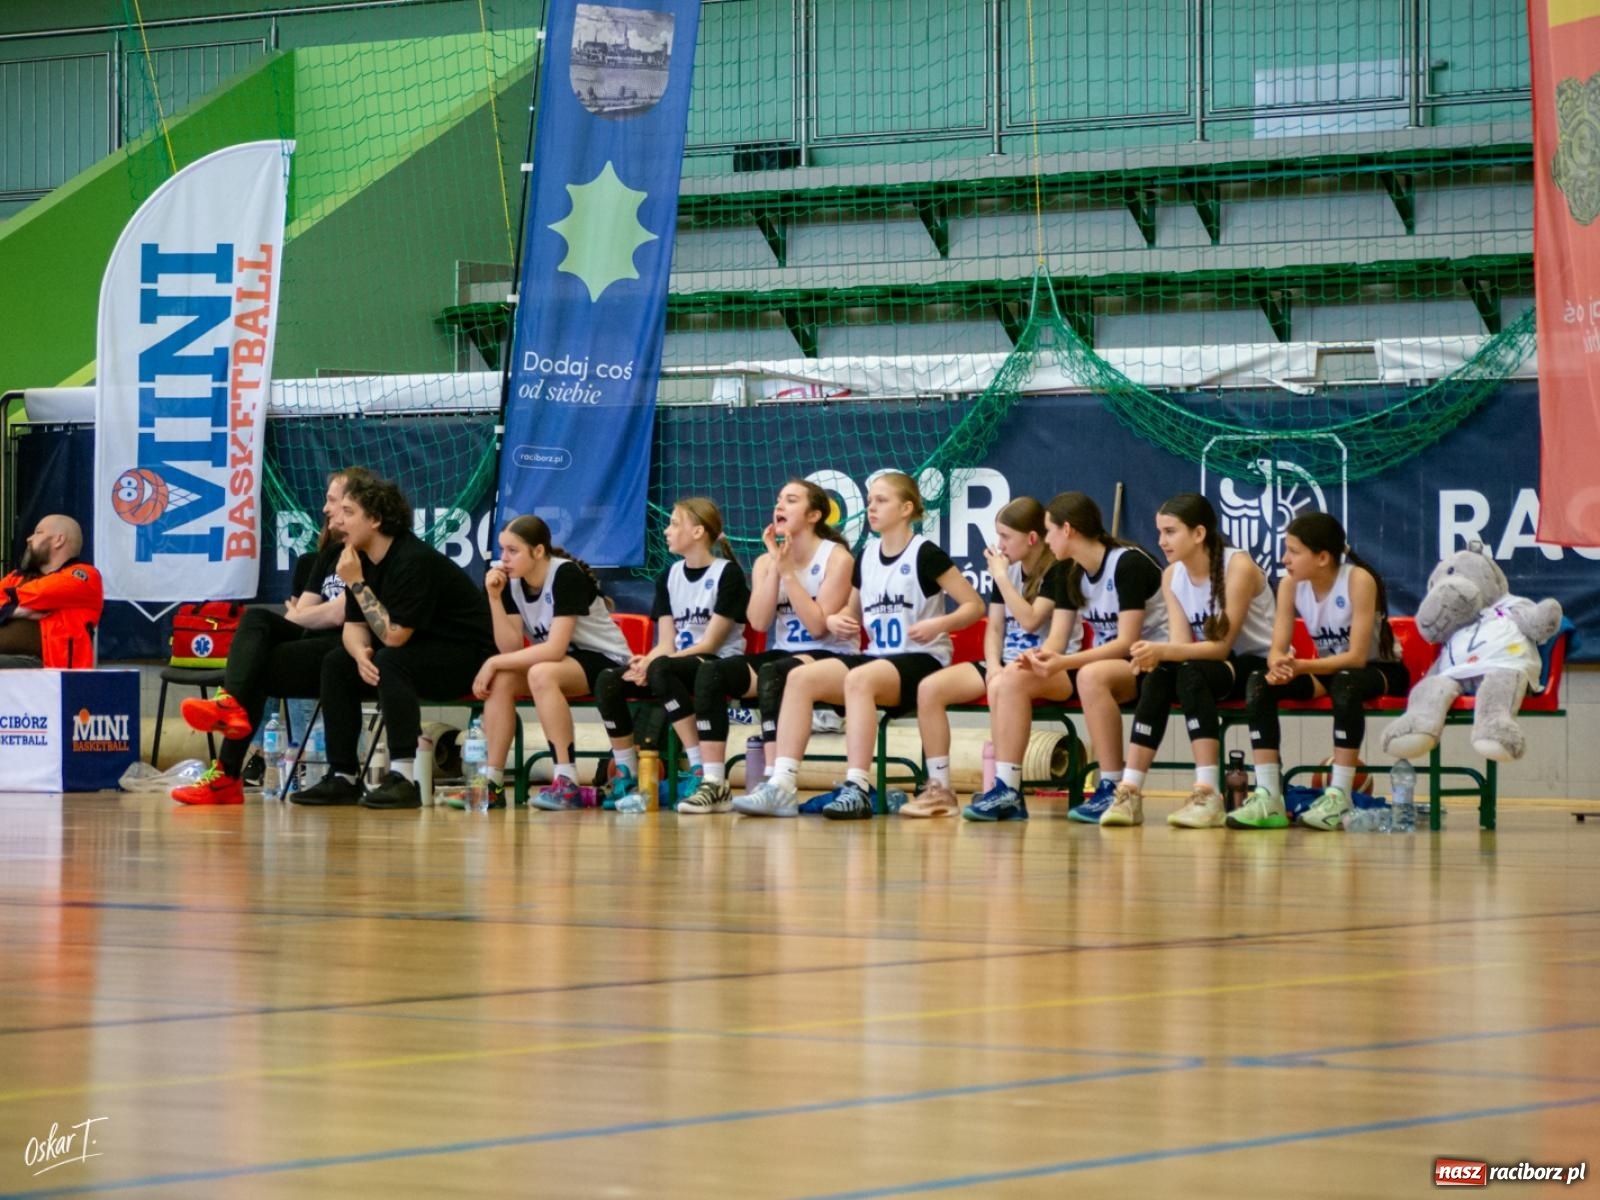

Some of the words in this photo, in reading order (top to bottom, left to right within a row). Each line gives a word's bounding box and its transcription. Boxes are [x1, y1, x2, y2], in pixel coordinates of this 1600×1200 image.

[523, 351, 589, 381] Dodaj
[596, 360, 634, 380] coś
[135, 243, 234, 562] MINI
[225, 243, 273, 561] BASKETBALL
[518, 379, 545, 399] od
[545, 381, 602, 404] siebie
[519, 452, 563, 464] raciborz.pl
[803, 467, 1010, 558] OiR
[869, 617, 901, 648] 10
[72, 714, 129, 741] MINI
[72, 741, 129, 752] BASKETBALL
